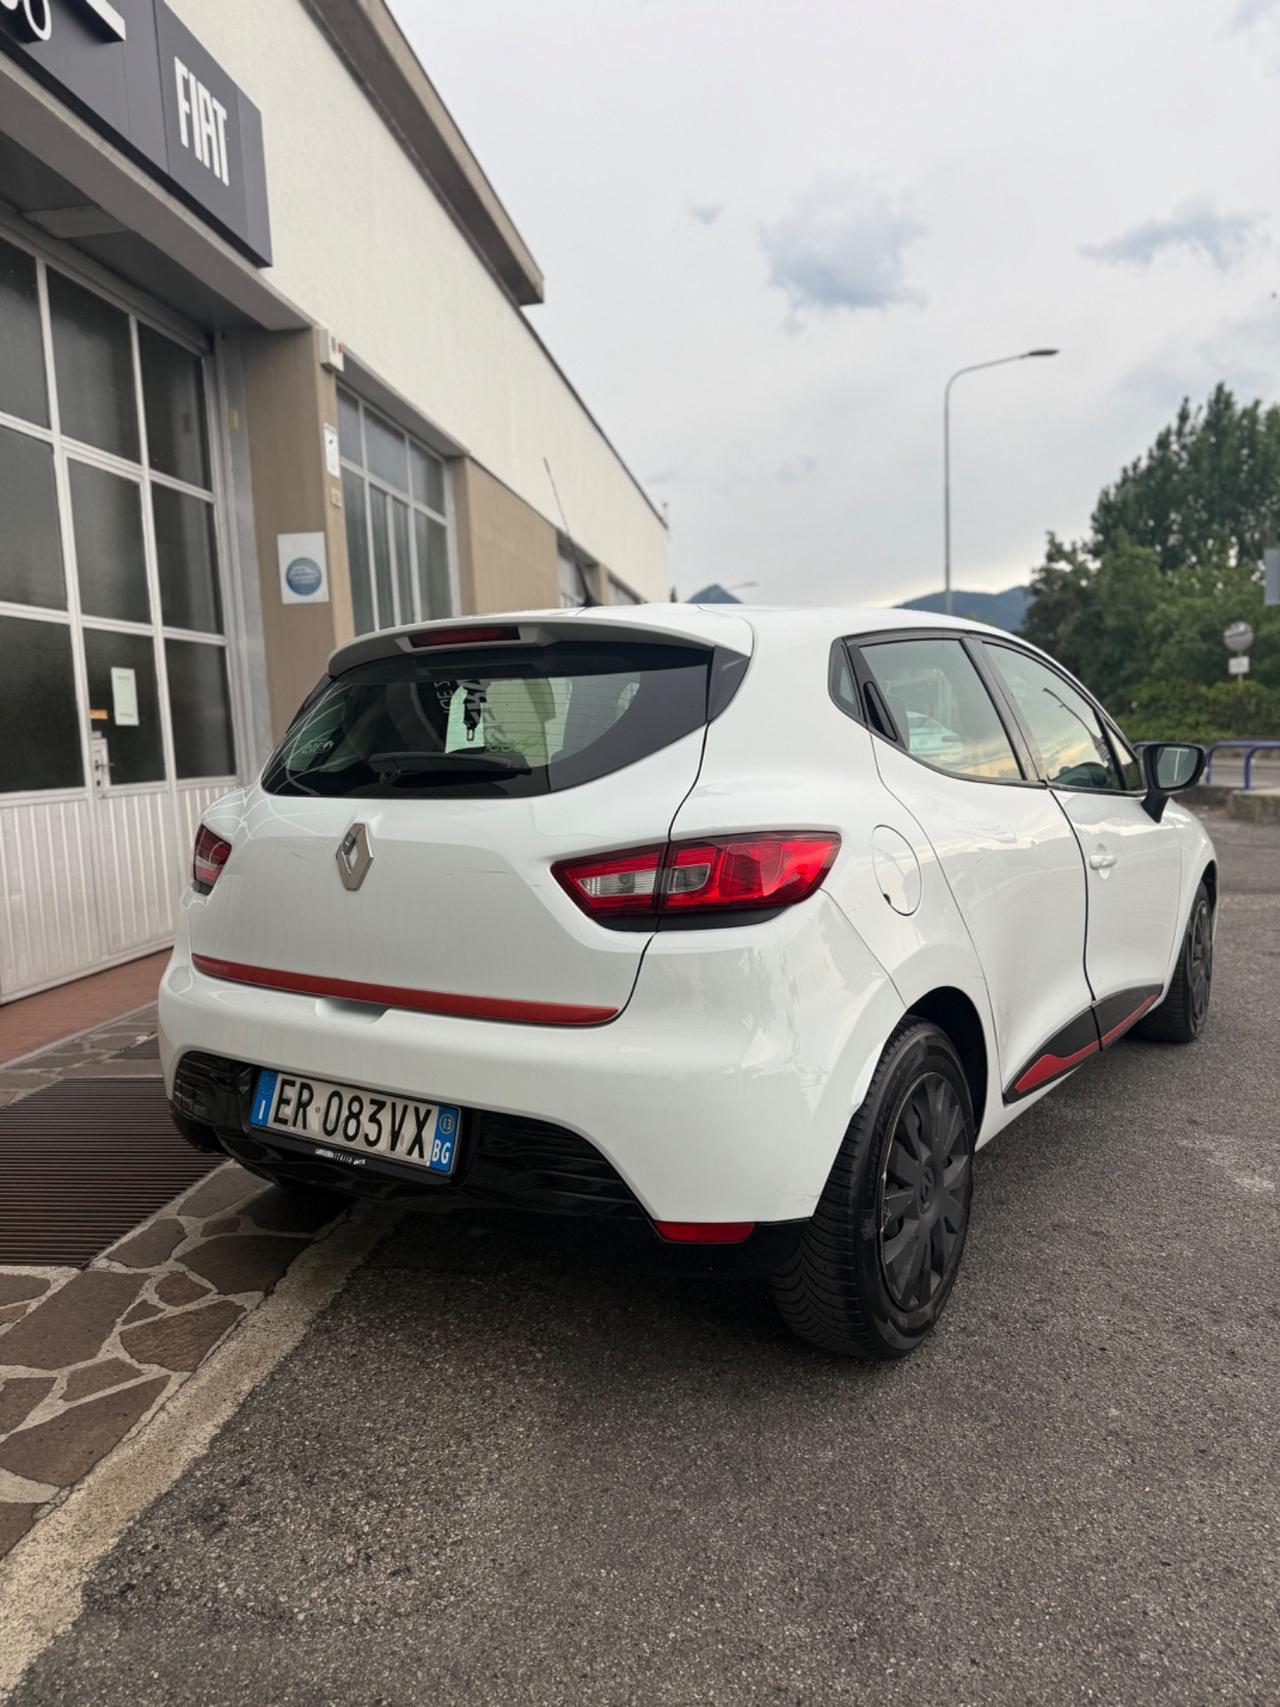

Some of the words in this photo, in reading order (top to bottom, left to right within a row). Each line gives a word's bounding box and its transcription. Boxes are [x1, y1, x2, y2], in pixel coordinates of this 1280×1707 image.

[174, 56, 229, 186] FIAT
[258, 1099, 266, 1120] I
[273, 1078, 314, 1129] ER
[322, 1090, 432, 1159] 083VX
[432, 1139, 451, 1165] BG
